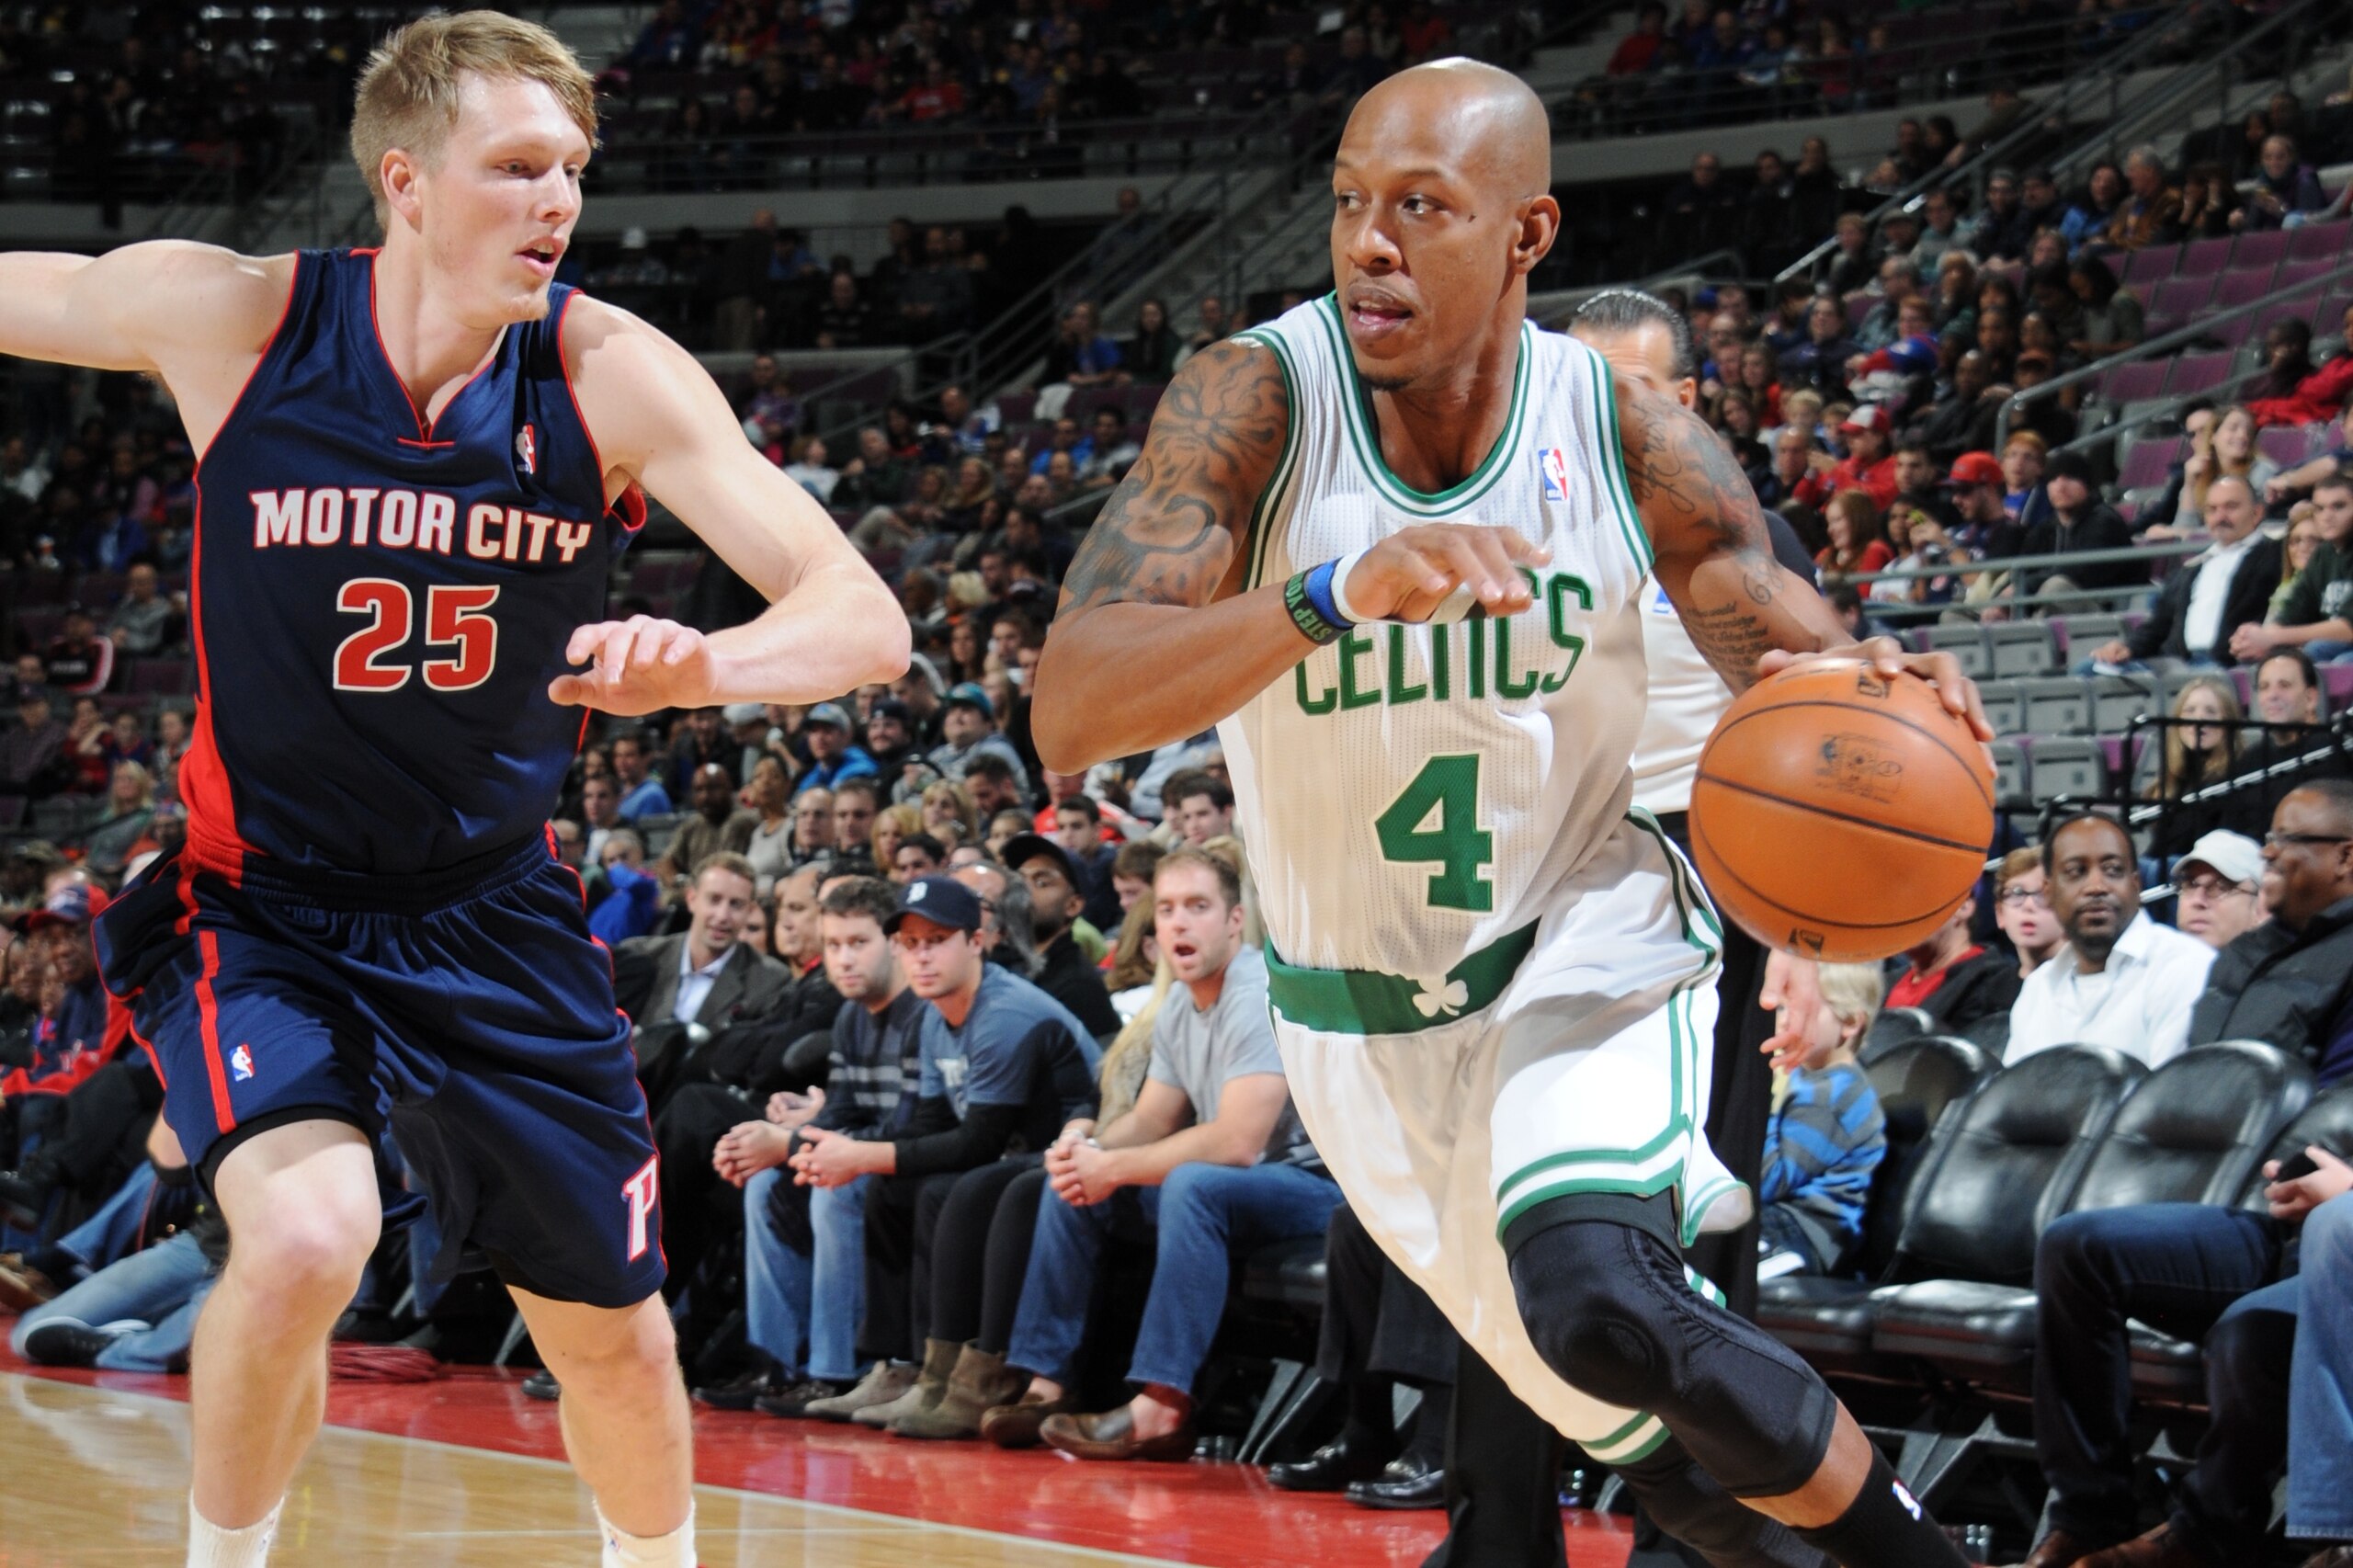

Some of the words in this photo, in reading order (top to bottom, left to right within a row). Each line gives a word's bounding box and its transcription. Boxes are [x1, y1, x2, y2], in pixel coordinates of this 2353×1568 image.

[249, 487, 456, 555] MOTOR
[465, 503, 592, 563] CITY
[333, 577, 500, 692] 25
[1293, 608, 1332, 641] STEP
[1370, 749, 1497, 915] 4
[622, 1153, 658, 1261] P
